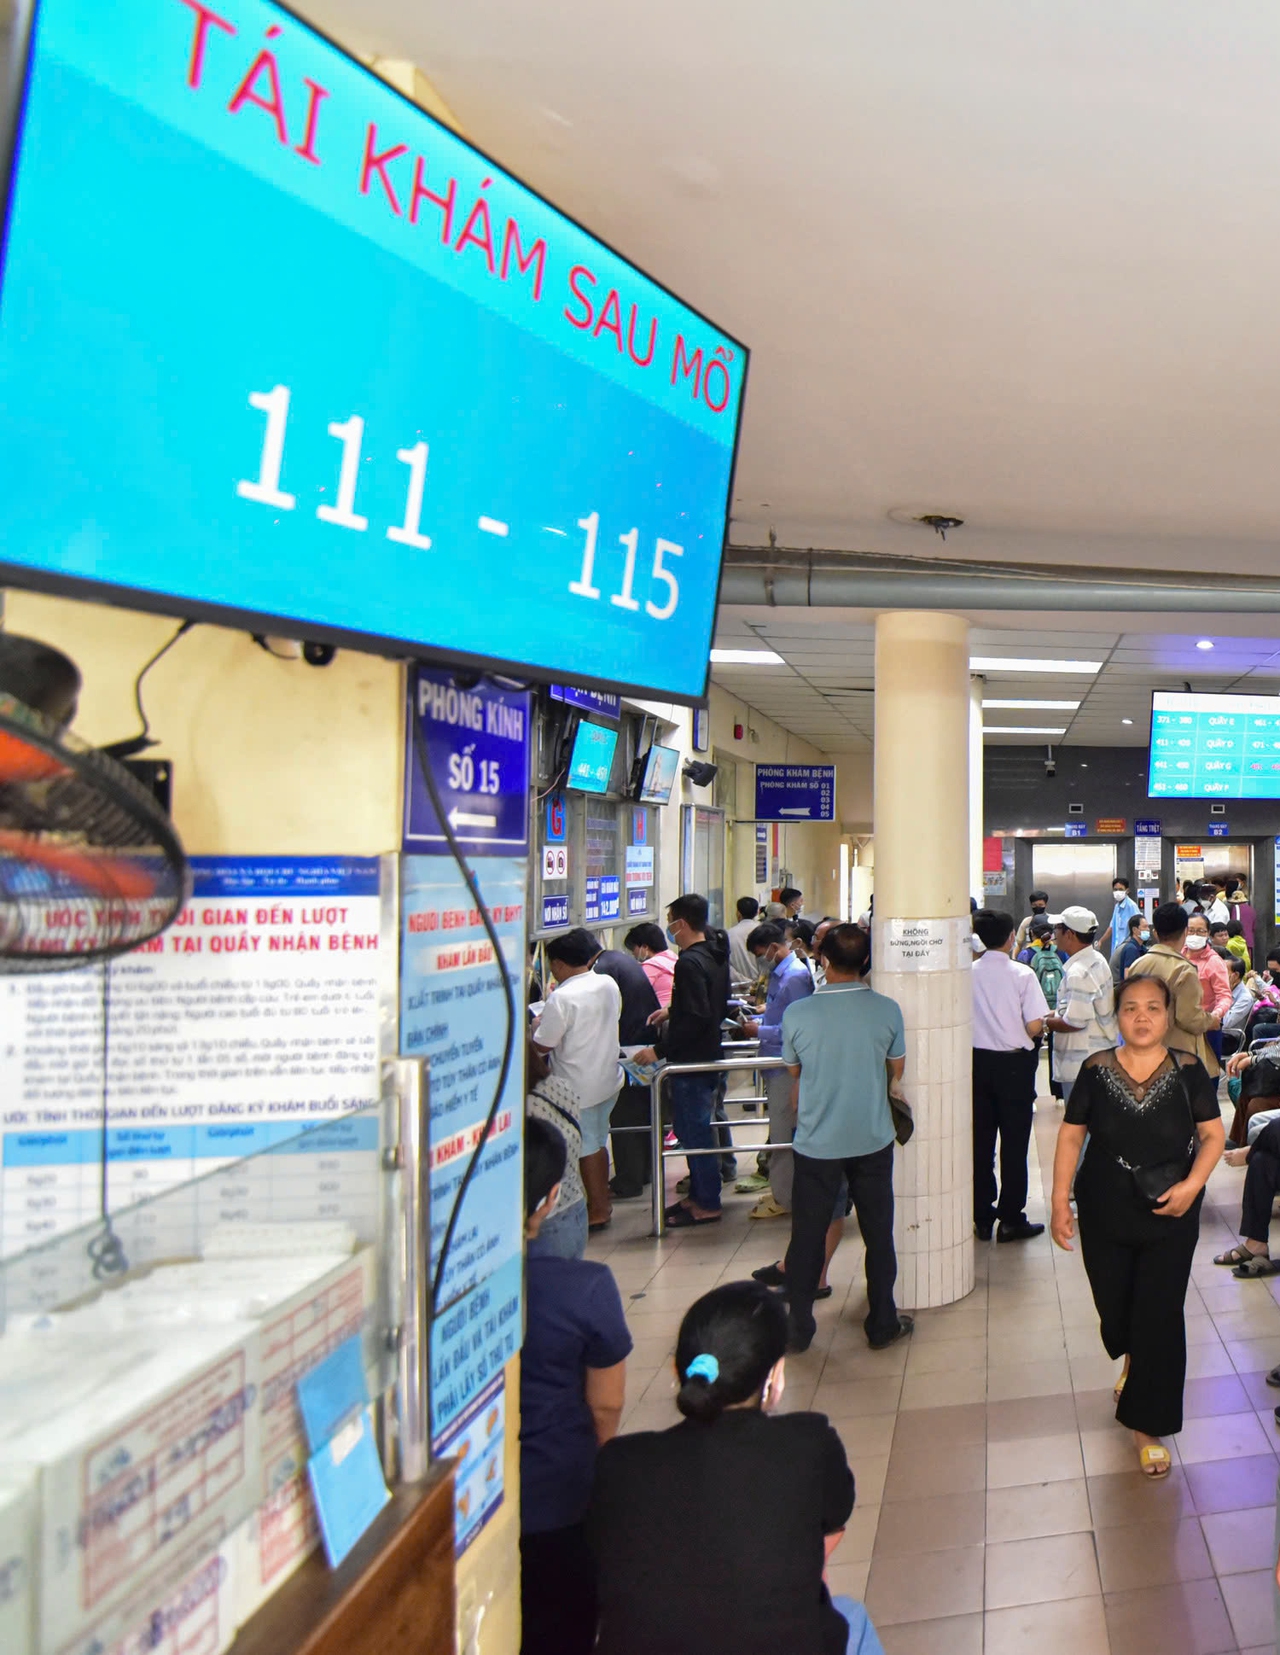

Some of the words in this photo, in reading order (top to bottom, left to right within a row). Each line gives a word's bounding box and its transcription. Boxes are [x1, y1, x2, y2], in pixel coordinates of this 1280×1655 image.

[178, 0, 331, 165] TÁI
[360, 122, 547, 301] KHÁM
[563, 265, 658, 367] SAU
[670, 333, 734, 414] MỔ
[236, 384, 433, 551] 111
[567, 511, 685, 621] 115
[419, 678, 483, 732] PHÒNG
[486, 696, 524, 742] KÍNH
[448, 743, 476, 791] SỐ
[479, 759, 500, 794] 15
[757, 767, 784, 777] PHÒNG
[786, 767, 810, 777] KHÁM
[811, 768, 834, 779] BỆNH
[760, 781, 784, 789] PHÒNG
[786, 781, 807, 789] KHÁM
[809, 780, 819, 789] SỐ
[551, 798, 563, 835] G
[202, 907, 248, 926] GIAN
[256, 902, 293, 925] ĐẾN
[301, 907, 349, 928] LƯỢT
[173, 936, 201, 956] TẠI
[210, 930, 261, 954] QUẦY
[269, 932, 321, 954] NHẬN
[329, 932, 379, 953] BỆNH
[902, 928, 929, 936] KHÔNG
[309, 1094, 339, 1111] BUỔI
